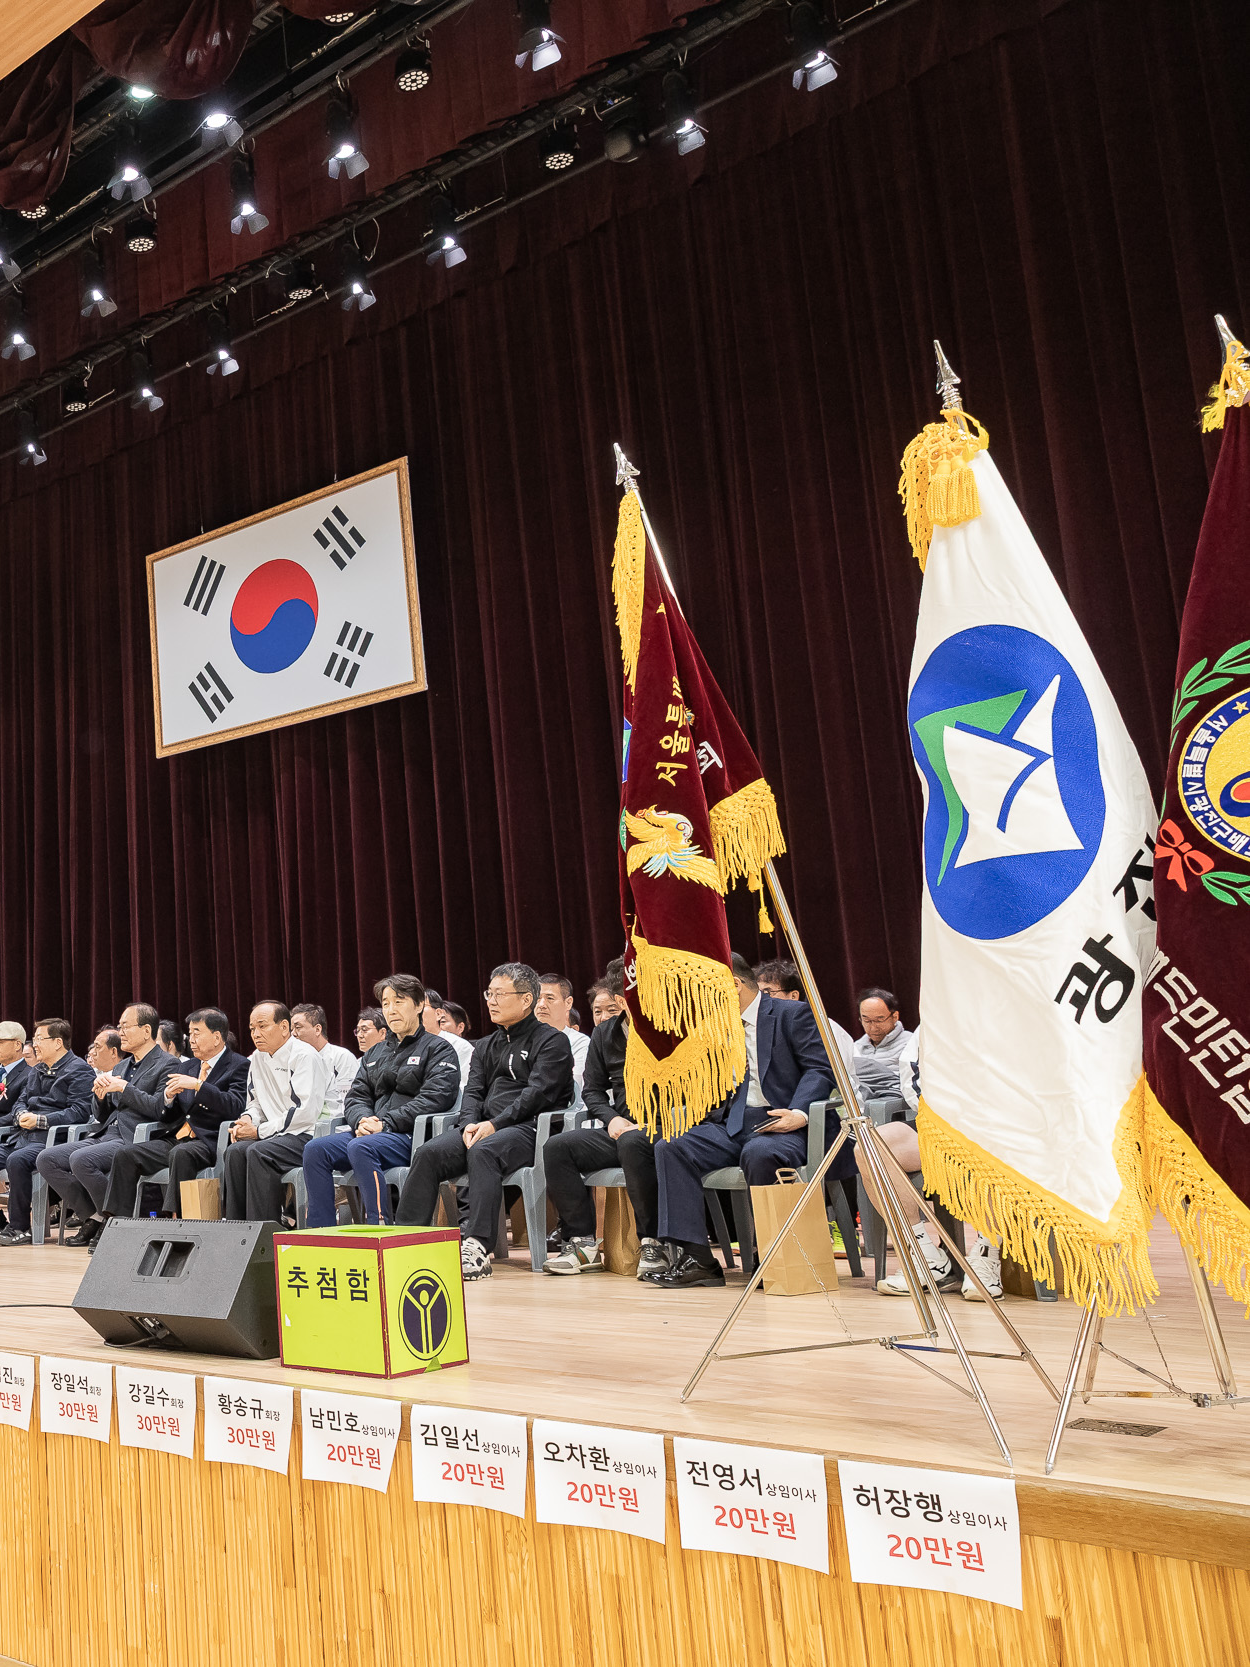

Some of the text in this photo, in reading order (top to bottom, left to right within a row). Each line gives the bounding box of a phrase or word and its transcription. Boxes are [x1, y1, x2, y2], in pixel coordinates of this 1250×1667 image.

[58, 1401, 99, 1424] 30만원
[137, 1414, 181, 1438] 30만원
[227, 1426, 276, 1453] 30만원
[326, 1443, 382, 1471] 20만원
[441, 1461, 506, 1491] 20만원
[565, 1481, 641, 1514] 20만원
[713, 1504, 797, 1541] 20만원
[886, 1533, 986, 1573] 20만원
